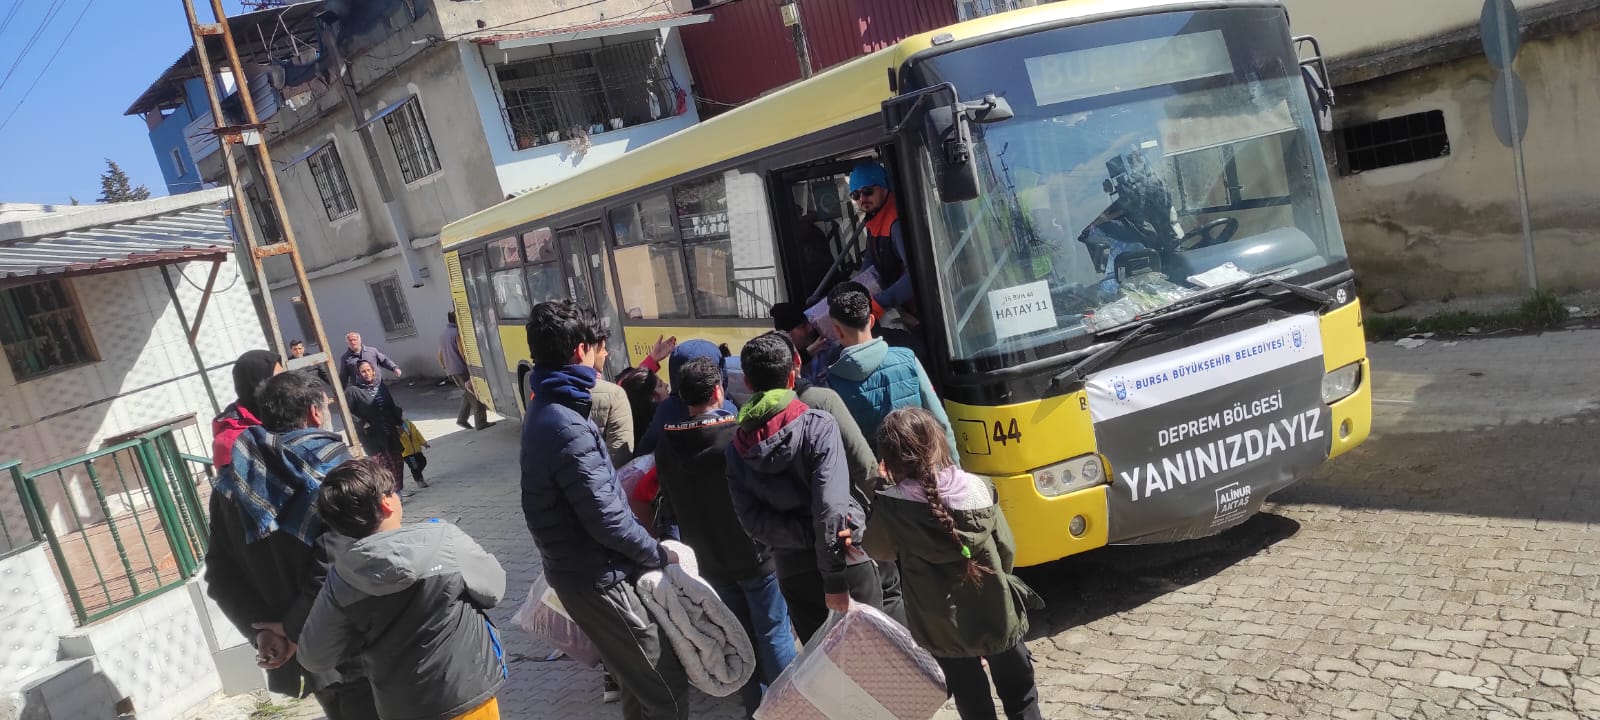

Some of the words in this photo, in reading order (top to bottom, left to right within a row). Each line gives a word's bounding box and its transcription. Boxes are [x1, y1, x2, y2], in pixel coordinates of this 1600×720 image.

[995, 302, 1033, 320] HATAY
[1035, 299, 1049, 312] 11
[1135, 374, 1169, 390] BURSA
[1172, 353, 1231, 380] BÜYÜKŞEHİR
[1235, 337, 1285, 361] BELEDİYESİ
[993, 417, 1022, 447] 44
[1158, 412, 1220, 447] DEPREM
[1223, 389, 1283, 426] BÖLGESİ
[1120, 407, 1324, 502] YANINIZDAYIZ
[1220, 485, 1251, 505] ALİNUR
